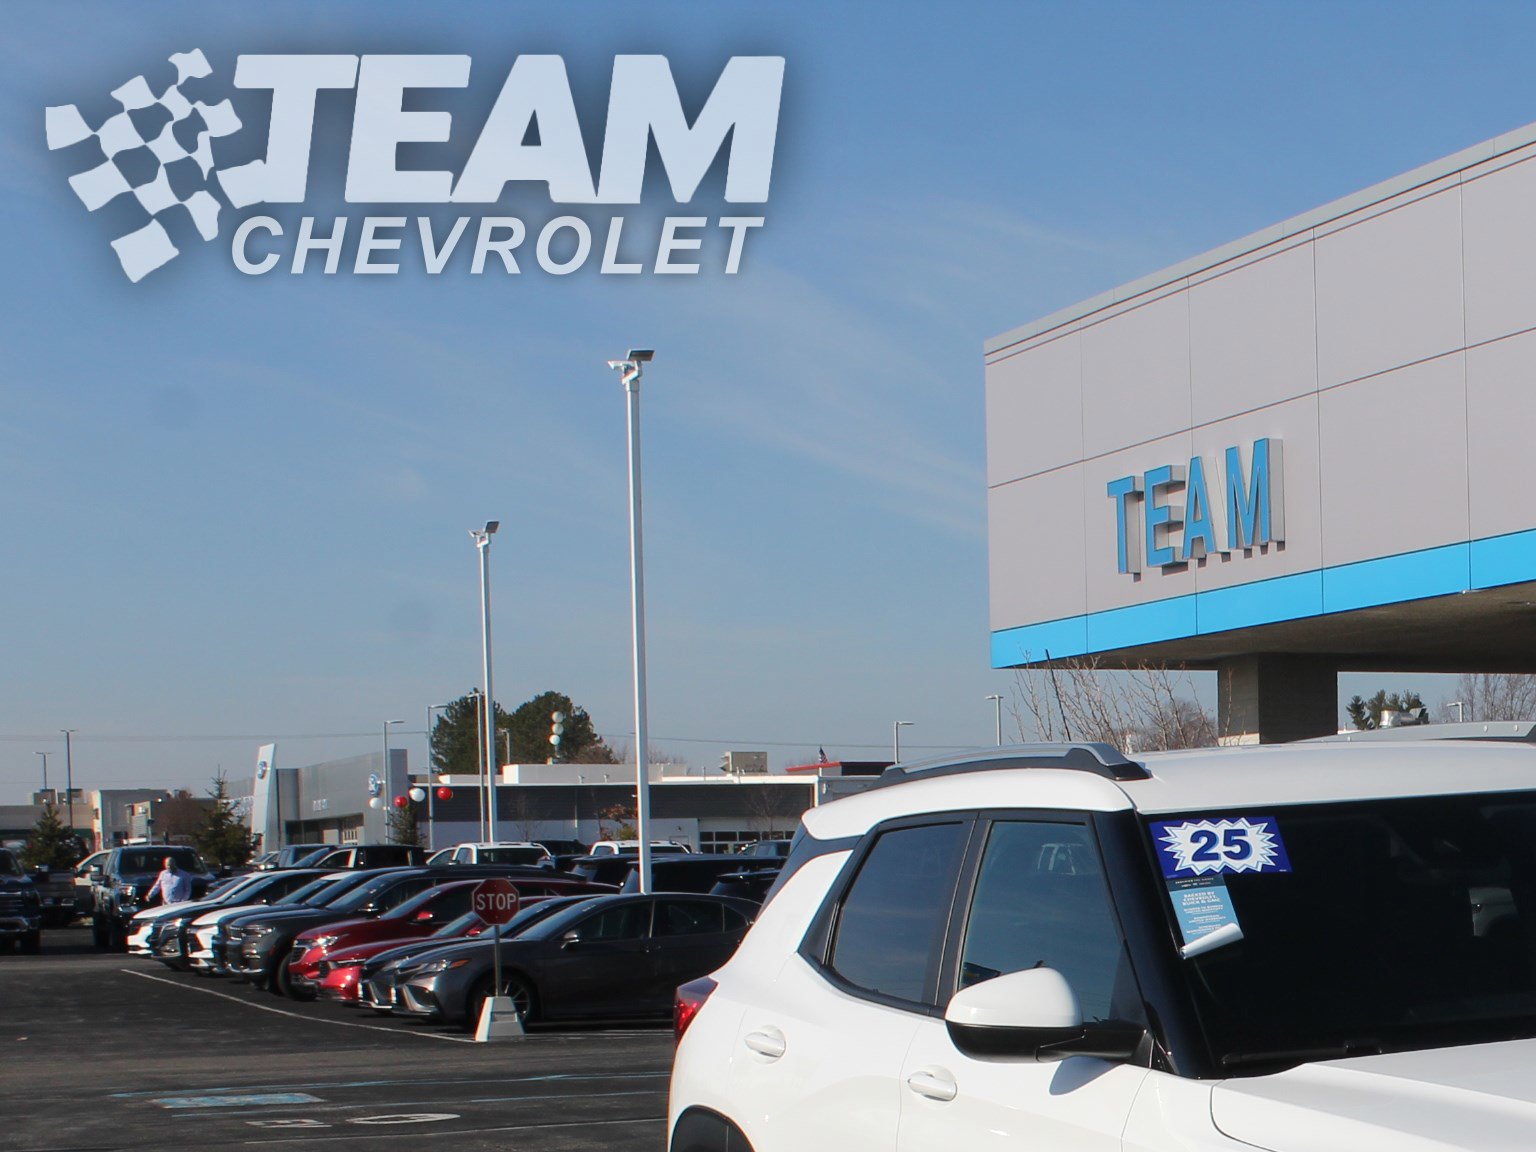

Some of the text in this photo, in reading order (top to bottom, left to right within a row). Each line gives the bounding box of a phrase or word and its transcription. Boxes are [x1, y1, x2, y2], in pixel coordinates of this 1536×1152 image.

[1106, 437, 1285, 576] TEAM
[1189, 828, 1253, 862] 25
[476, 893, 517, 911] STOP
